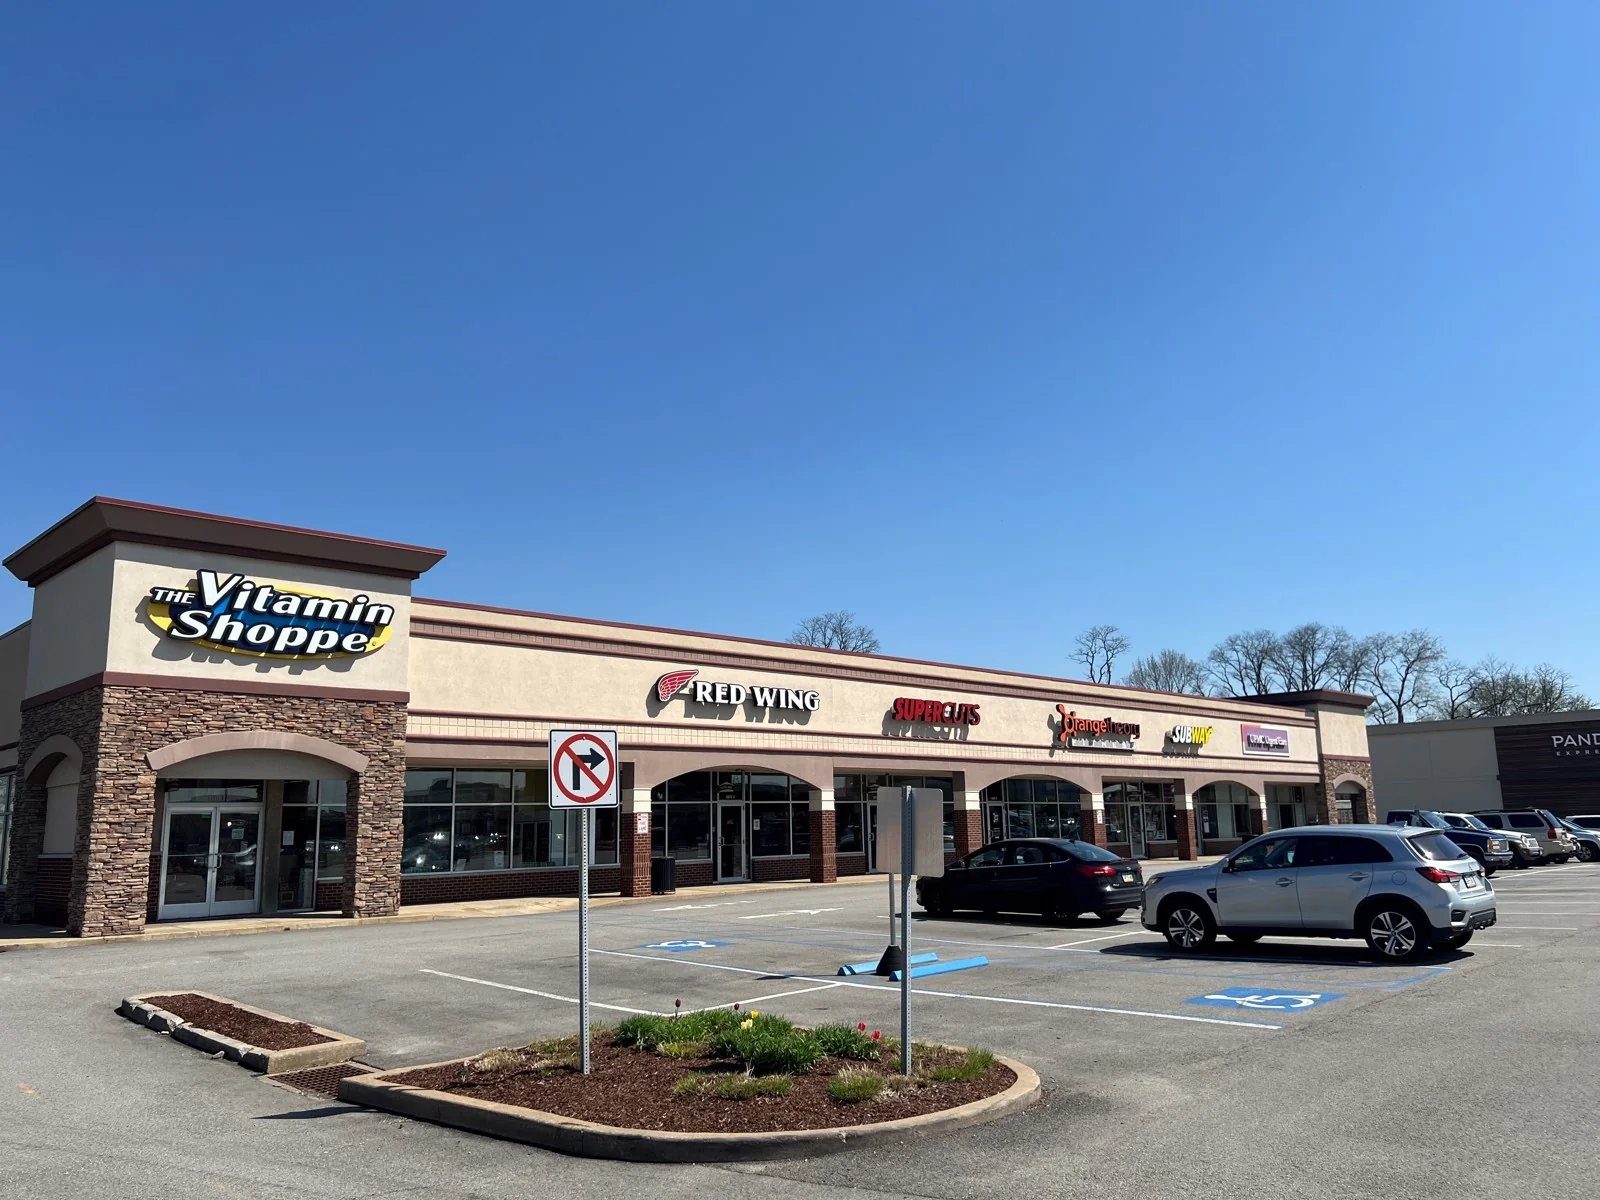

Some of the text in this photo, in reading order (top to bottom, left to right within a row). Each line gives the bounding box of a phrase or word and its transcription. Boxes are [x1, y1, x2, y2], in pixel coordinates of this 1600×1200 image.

[152, 570, 394, 625] THE Vitamin
[170, 609, 369, 654] Shoppe
[694, 681, 820, 712] RED WING
[894, 697, 980, 725] SUPERCUTS
[1060, 707, 1140, 741] Orangetheory
[1172, 725, 1214, 744] SUBWAY
